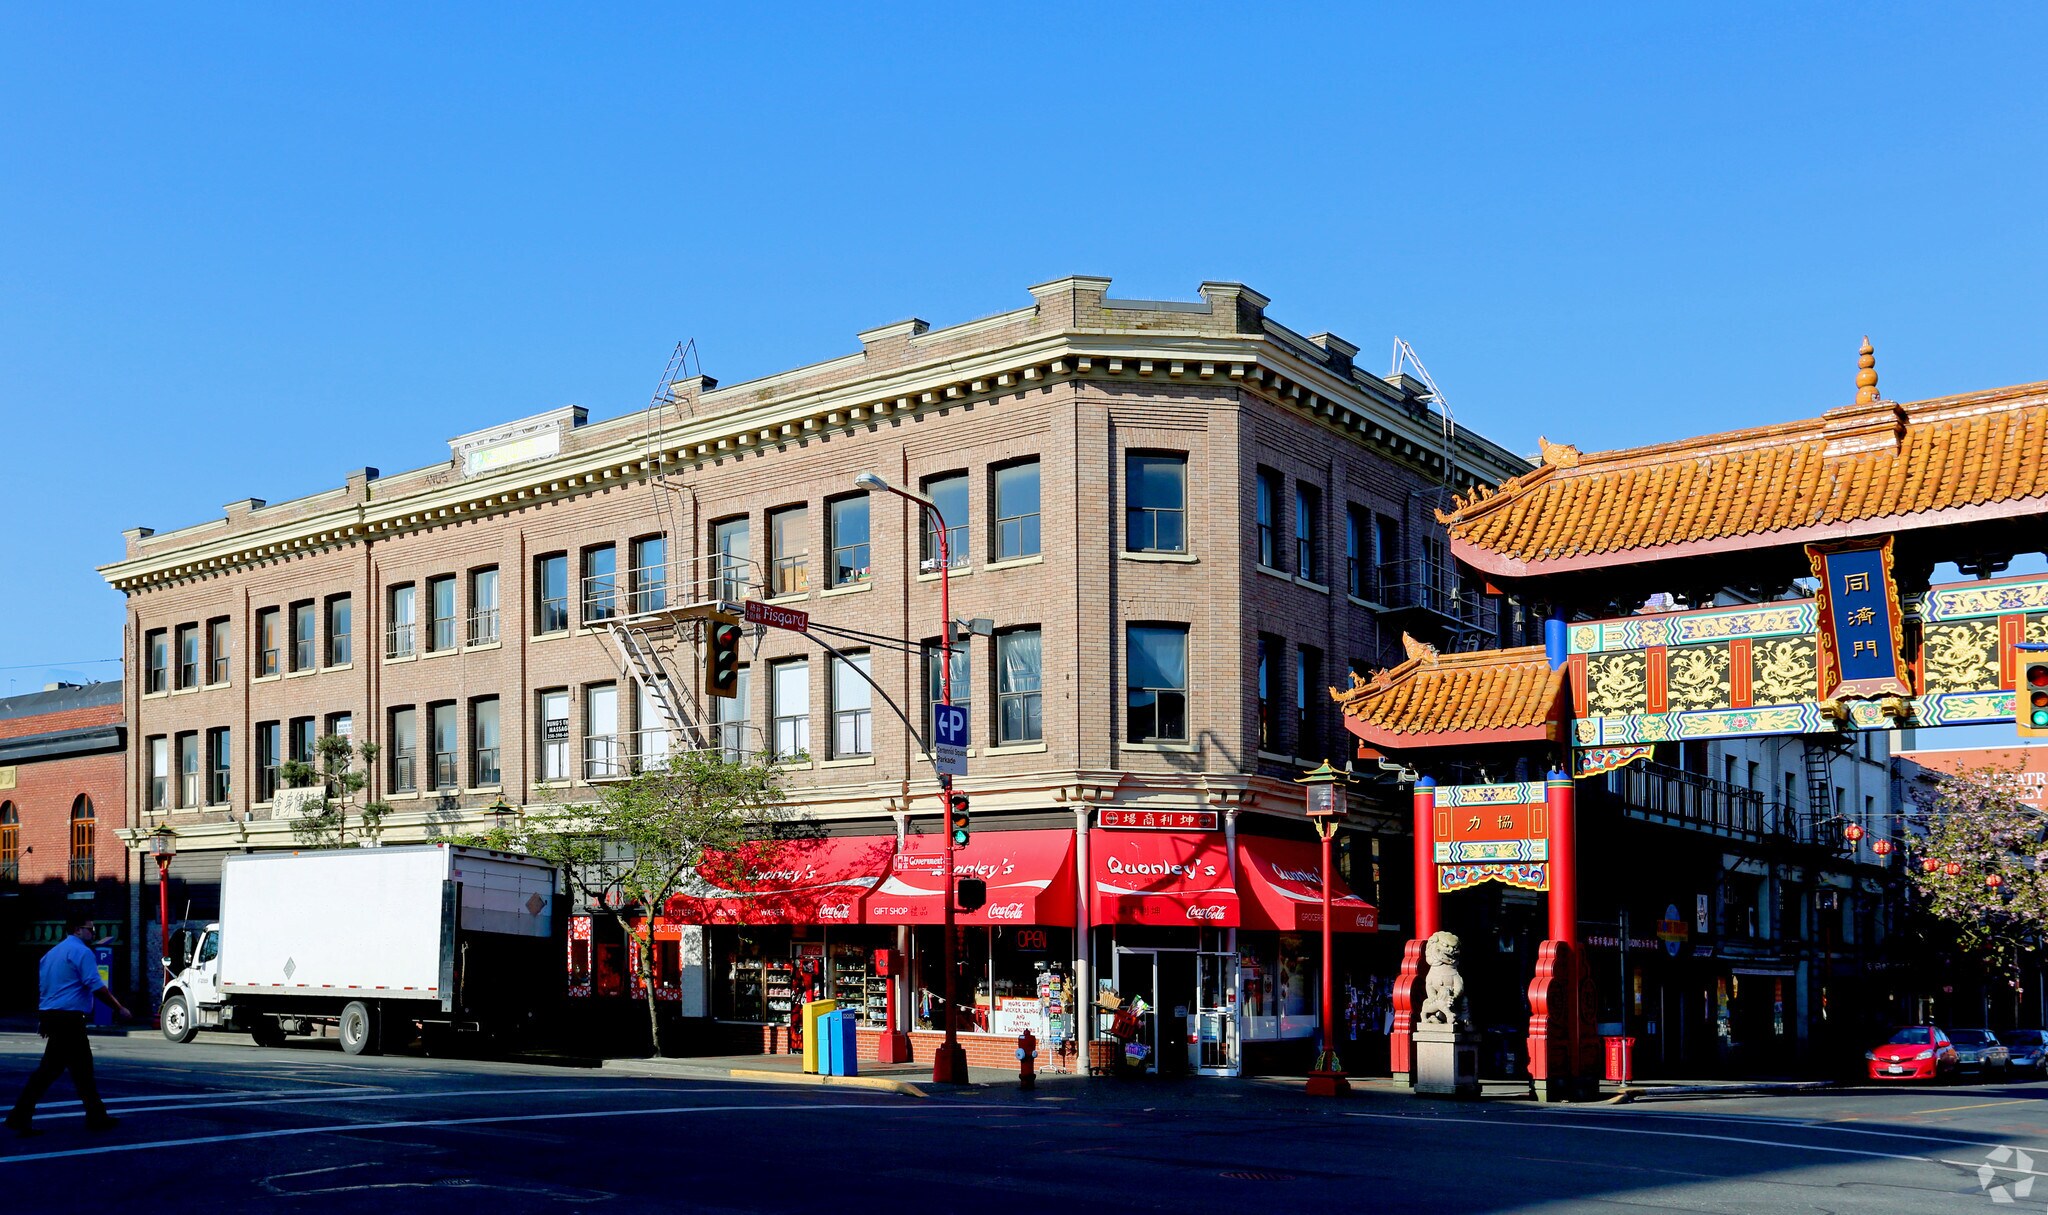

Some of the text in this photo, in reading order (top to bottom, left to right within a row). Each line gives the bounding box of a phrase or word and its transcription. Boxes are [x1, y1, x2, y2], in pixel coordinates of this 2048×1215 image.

[762, 606, 805, 627] Fisgard
[1845, 572, 1878, 658] 同濟門
[950, 710, 964, 741] P
[937, 755, 956, 764] Parkade
[909, 855, 943, 866] Government
[761, 908, 785, 917] WICKER
[873, 907, 909, 915] GIFT SHOP
[988, 902, 1024, 919] Coca-Cola
[1186, 905, 1227, 920] Coca-Cola
[1356, 913, 1374, 928] Coca-Cola
[666, 924, 682, 933] TEAS
[1018, 930, 1047, 949] OPEN
[101, 952, 107, 960] P
